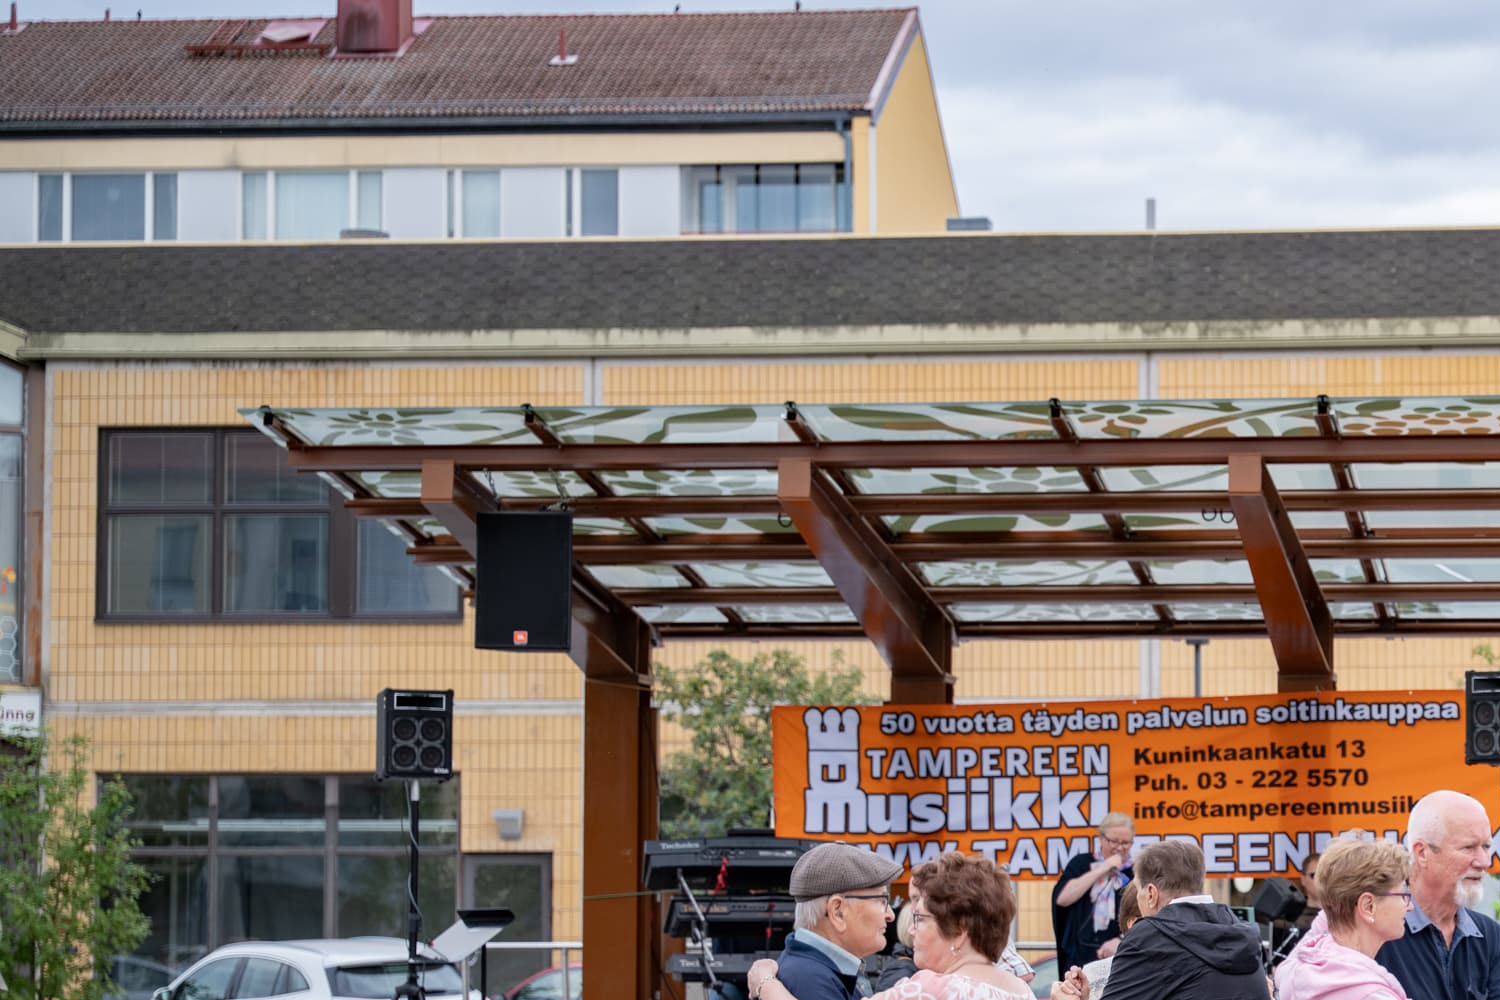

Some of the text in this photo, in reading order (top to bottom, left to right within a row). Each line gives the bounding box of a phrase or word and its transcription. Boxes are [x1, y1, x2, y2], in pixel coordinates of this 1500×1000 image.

[880, 711, 916, 735] 50
[923, 709, 1014, 734] vuotta
[1021, 707, 1119, 737] täyden
[1126, 704, 1248, 735] palvelun
[1254, 698, 1460, 726] soitinkauppaa
[865, 744, 1110, 780] TAMPEREEN
[1134, 739, 1366, 766] Kuninkaankatu 13
[1134, 773, 1189, 792] Puh.
[1197, 772, 1227, 790] 03
[1251, 769, 1298, 788] 222
[1306, 767, 1369, 788] 5570
[1133, 795, 1425, 822] info@tampereenmusiik
